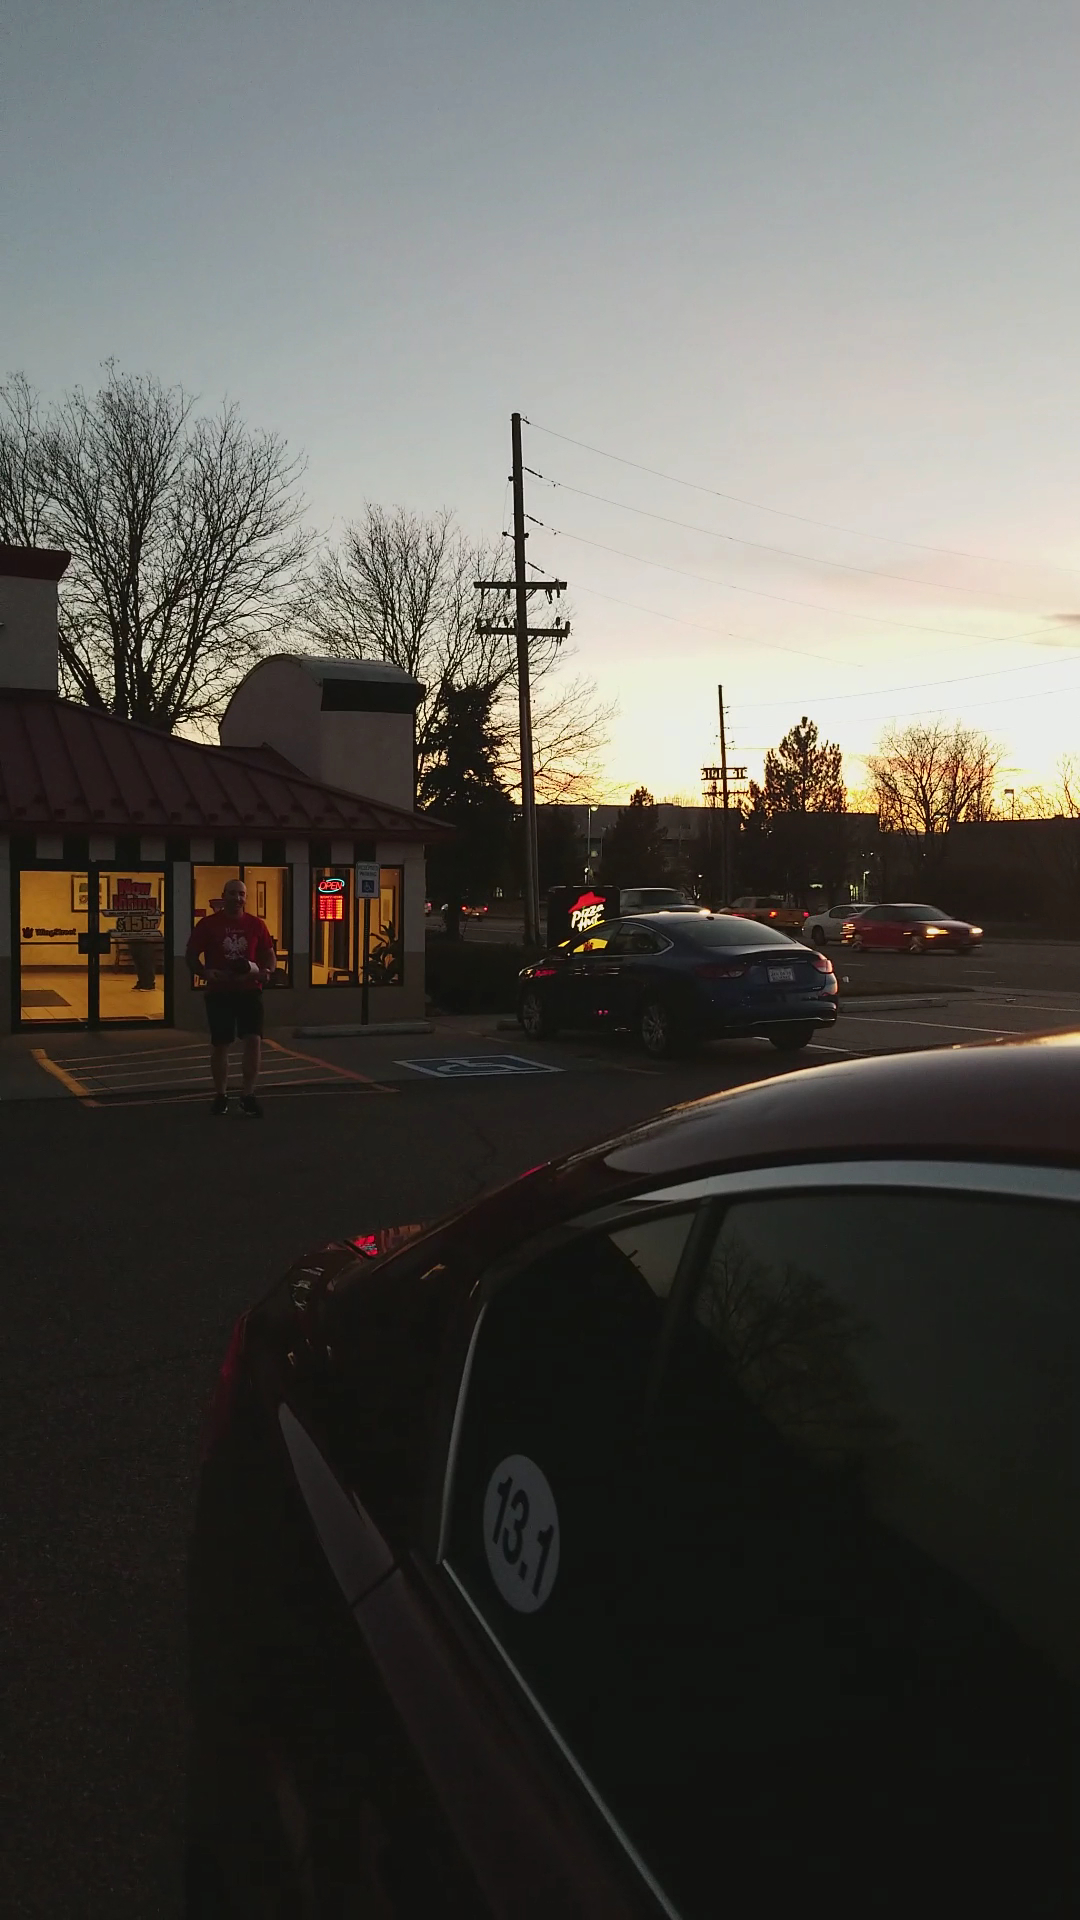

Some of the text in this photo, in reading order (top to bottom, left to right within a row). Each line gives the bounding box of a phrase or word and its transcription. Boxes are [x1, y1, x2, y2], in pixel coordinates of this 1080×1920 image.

[117, 879, 151, 895] Now
[319, 881, 343, 891] OPEN
[112, 894, 157, 916] Hiring
[571, 904, 605, 929] Pizza
[577, 913, 602, 932] Hut
[492, 1476, 554, 1597] 13.1
